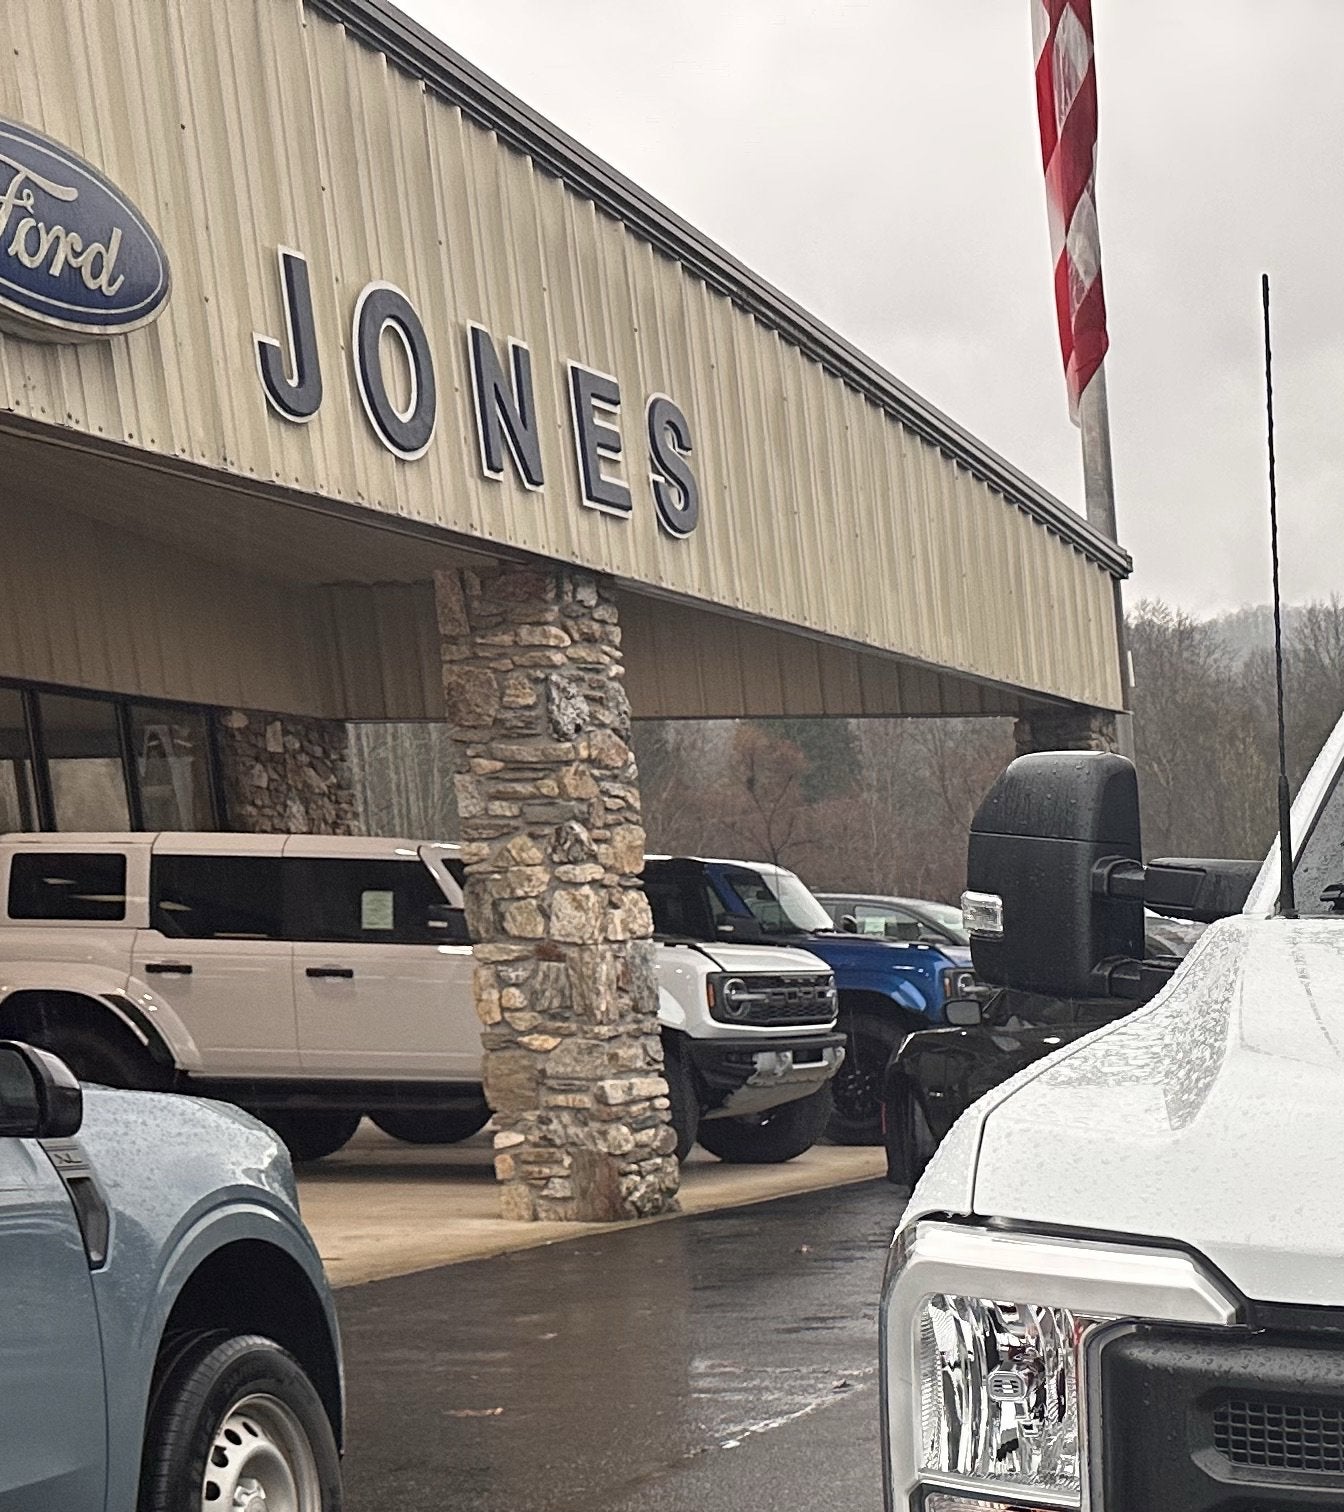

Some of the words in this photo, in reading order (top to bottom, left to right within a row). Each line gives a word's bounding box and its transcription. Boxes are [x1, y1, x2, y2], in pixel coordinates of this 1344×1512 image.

[0, 154, 125, 296] Ford
[253, 245, 698, 539] JONES
[53, 1152, 83, 1165] XL
